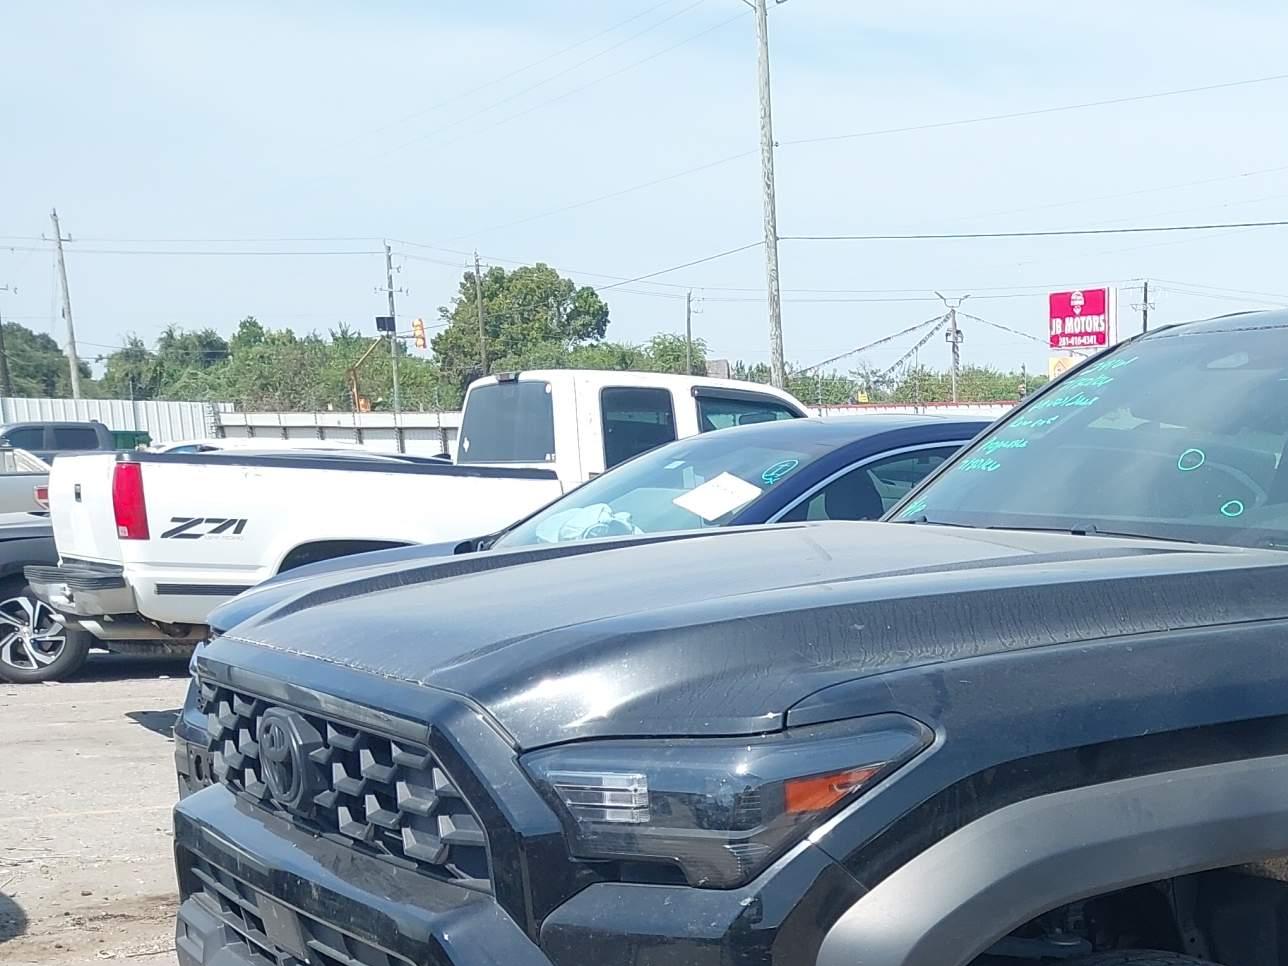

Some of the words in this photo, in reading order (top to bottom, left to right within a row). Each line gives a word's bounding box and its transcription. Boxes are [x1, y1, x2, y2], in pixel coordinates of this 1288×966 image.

[1050, 318, 1063, 335] JB
[1064, 315, 1105, 334] MOTORS
[160, 516, 248, 539] Z71
